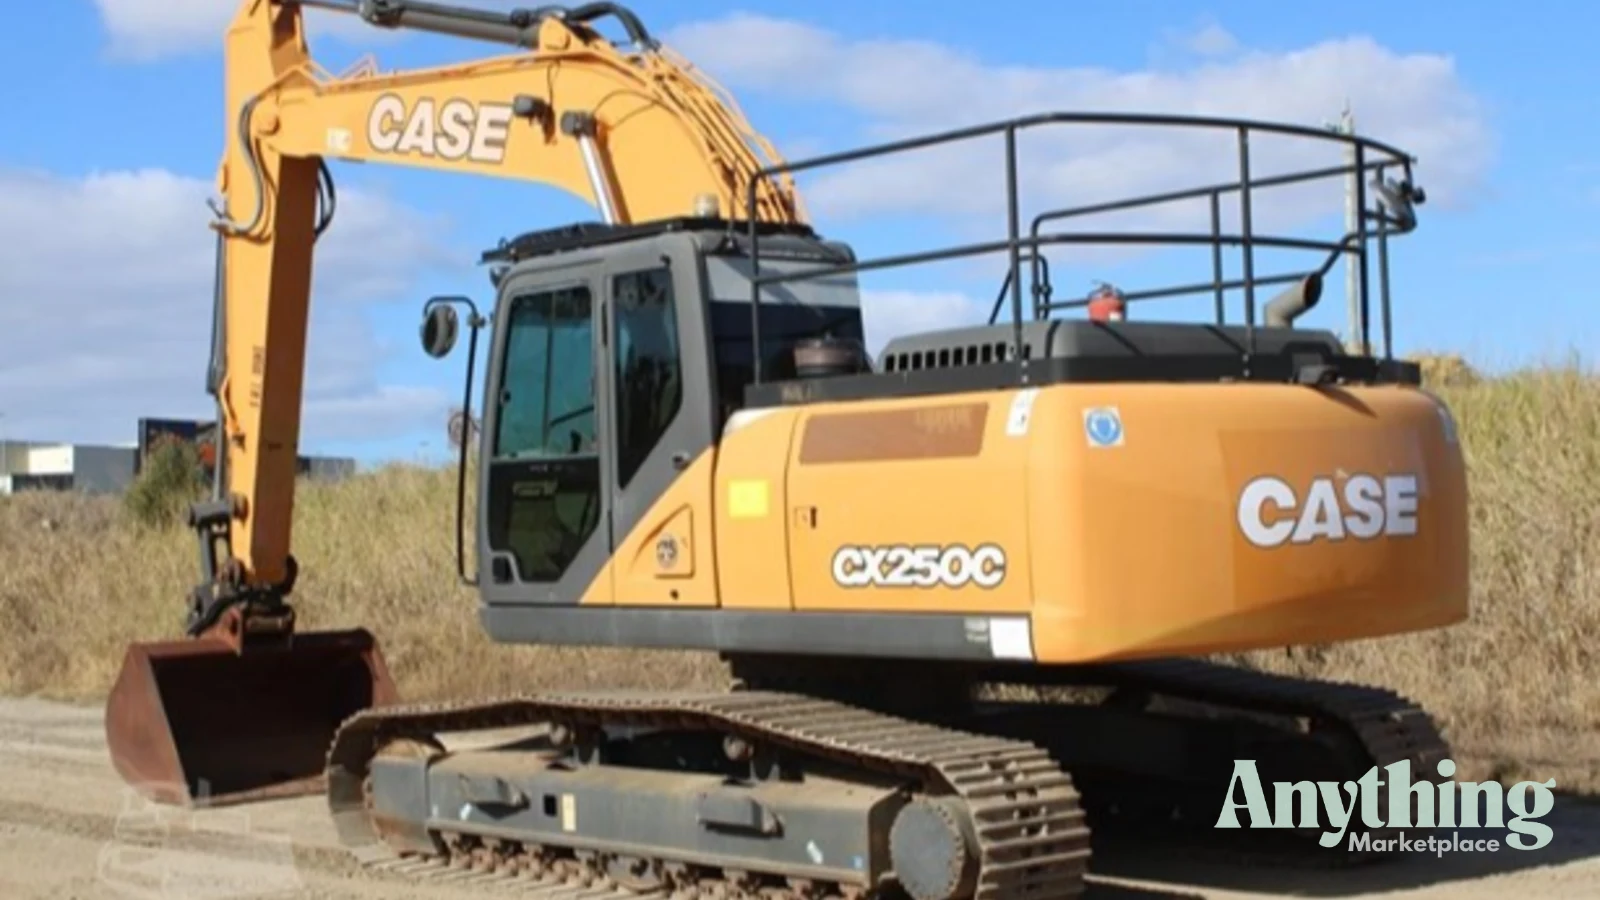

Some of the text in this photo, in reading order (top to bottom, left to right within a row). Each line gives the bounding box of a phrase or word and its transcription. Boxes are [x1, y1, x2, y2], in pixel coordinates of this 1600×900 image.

[368, 93, 513, 164] CASE
[1237, 475, 1420, 548] CASE
[832, 542, 1007, 589] CX250C
